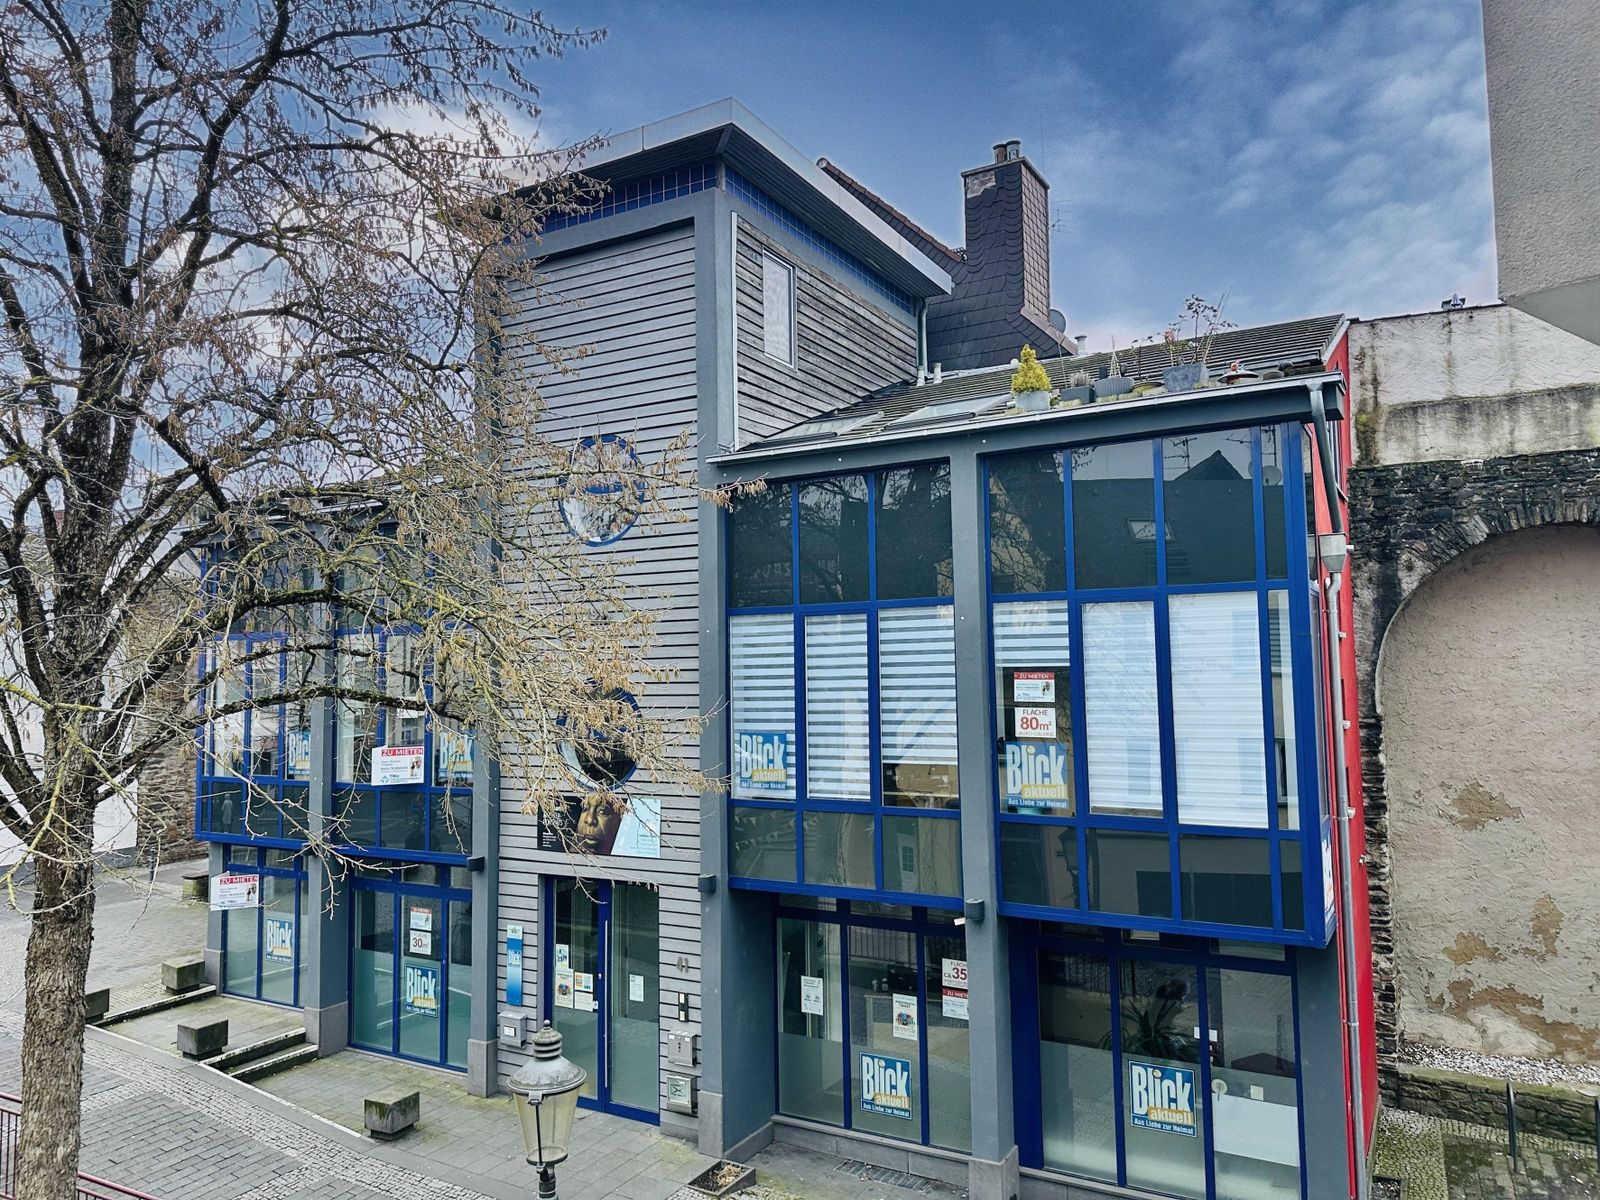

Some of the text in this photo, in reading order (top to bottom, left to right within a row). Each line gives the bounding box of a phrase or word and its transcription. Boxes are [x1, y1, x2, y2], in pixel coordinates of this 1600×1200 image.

[741, 734, 784, 778] Blick
[1006, 744, 1064, 794] Blick
[1020, 798, 1035, 806] Liebe
[1047, 800, 1068, 808] Heimat
[1024, 786, 1067, 799] aktuell
[267, 920, 291, 952] Blick
[676, 956, 688, 972] 41
[406, 967, 436, 1002] Blick
[862, 1056, 908, 1100] Blick
[1132, 1066, 1190, 1114] Blick
[876, 1094, 910, 1108] aktuell
[1134, 1118, 1144, 1126] Aus
[1146, 1120, 1162, 1128] Liebe
[1172, 1124, 1194, 1134] Heimat
[1150, 1108, 1192, 1125] aktuell
